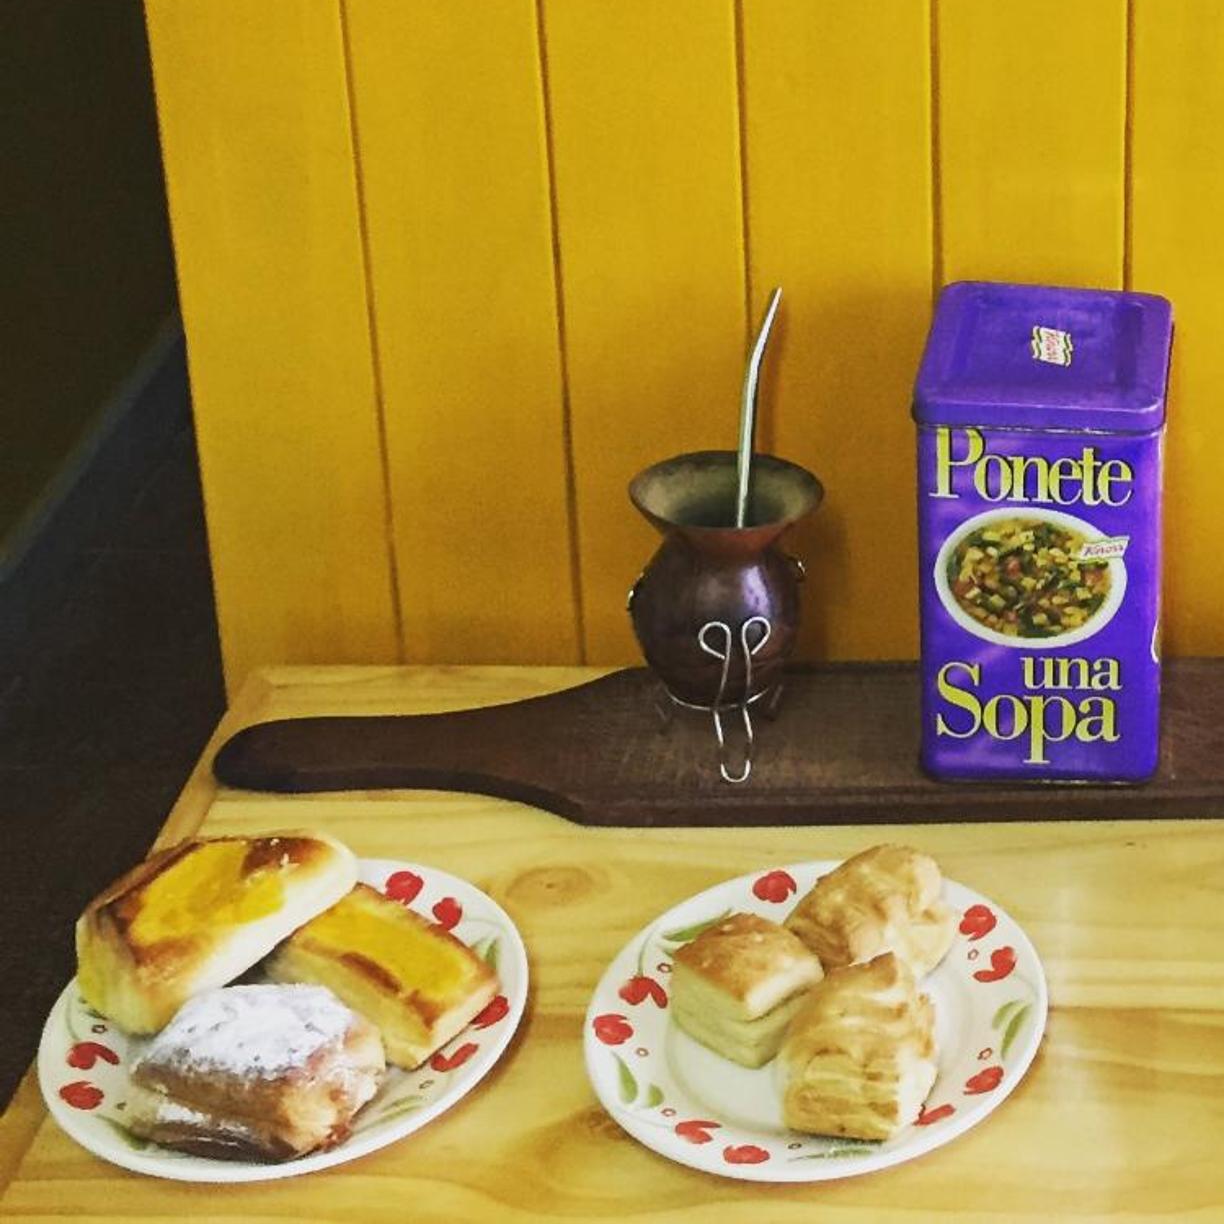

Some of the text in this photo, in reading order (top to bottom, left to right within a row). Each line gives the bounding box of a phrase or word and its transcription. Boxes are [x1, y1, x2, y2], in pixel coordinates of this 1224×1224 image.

[928, 426, 1134, 507] Ponete
[935, 661, 1121, 765] Sopa
[1019, 655, 1122, 691] una
